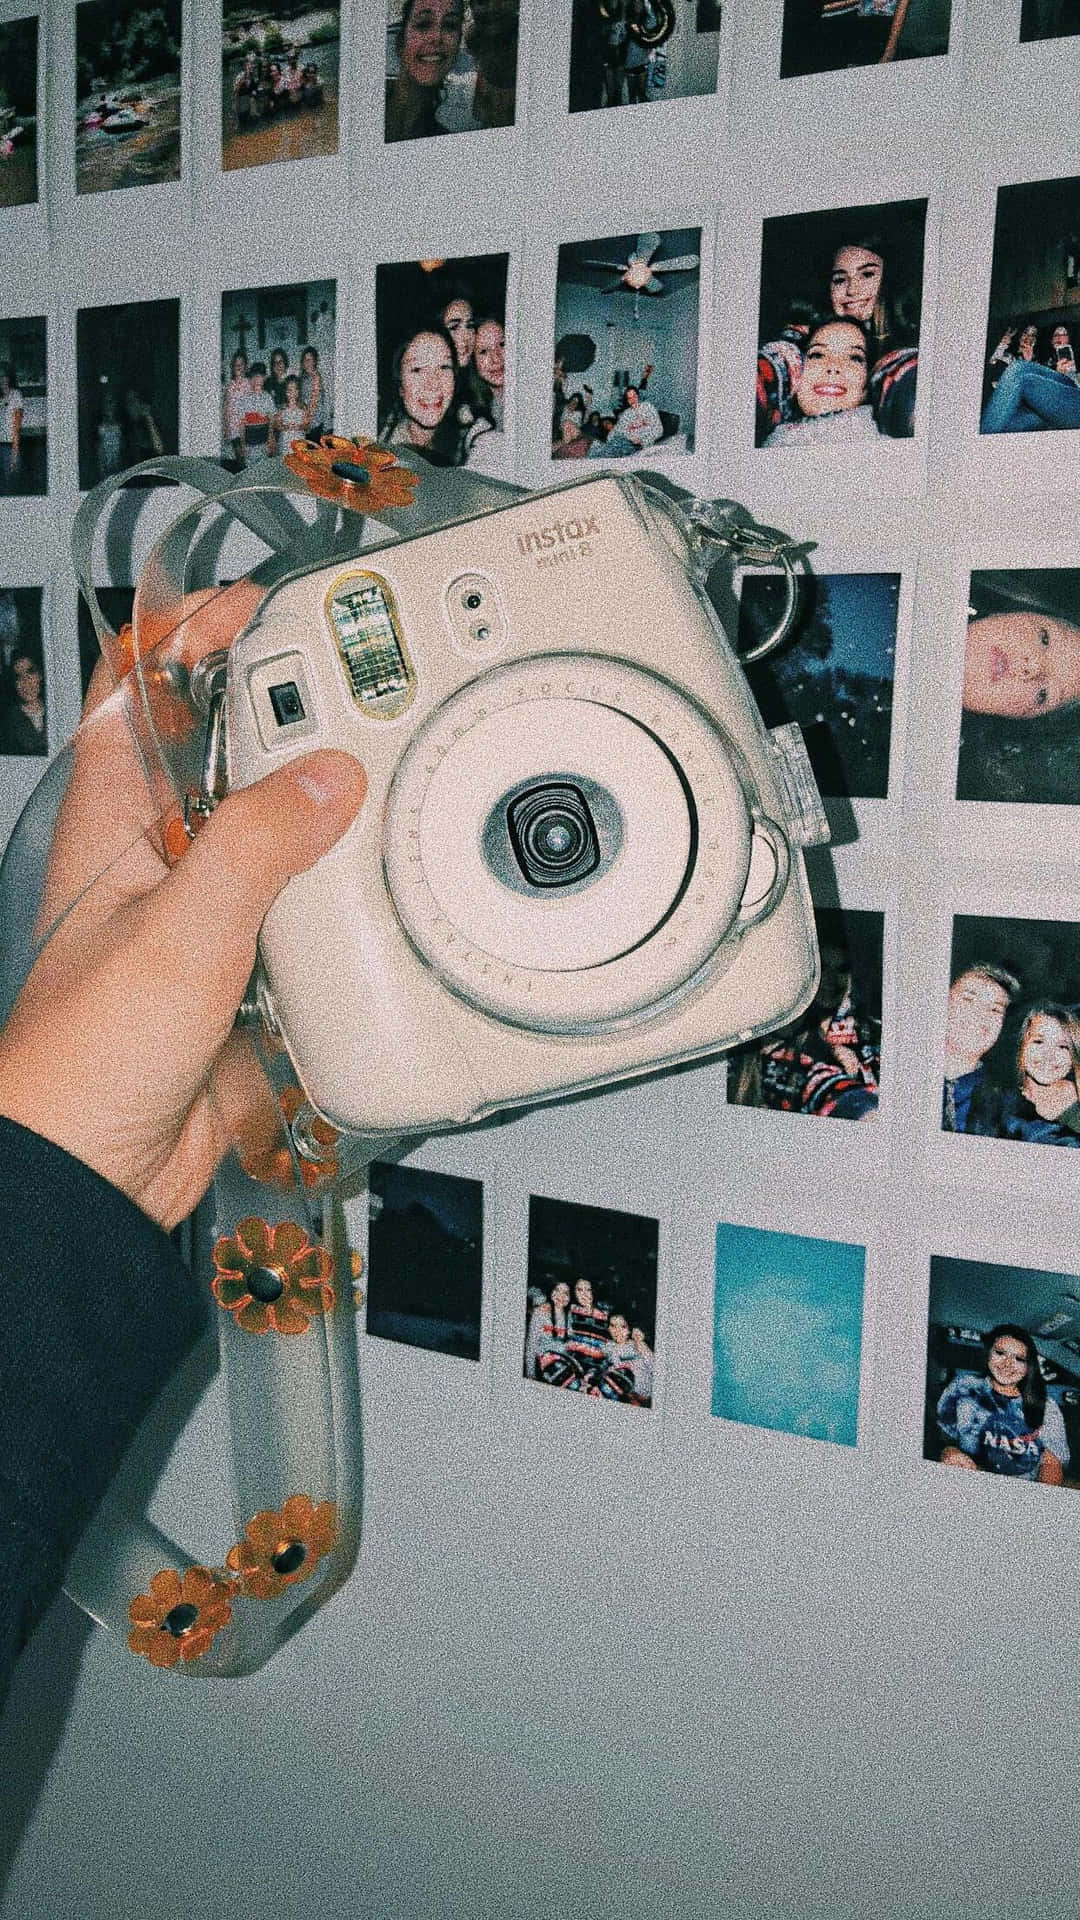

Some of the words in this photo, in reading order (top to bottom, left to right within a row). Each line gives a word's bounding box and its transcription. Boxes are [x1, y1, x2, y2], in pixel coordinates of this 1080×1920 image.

[518, 516, 600, 555] instax
[536, 546, 577, 569] mini
[580, 541, 592, 557] 8
[984, 1430, 1039, 1456] NASA
